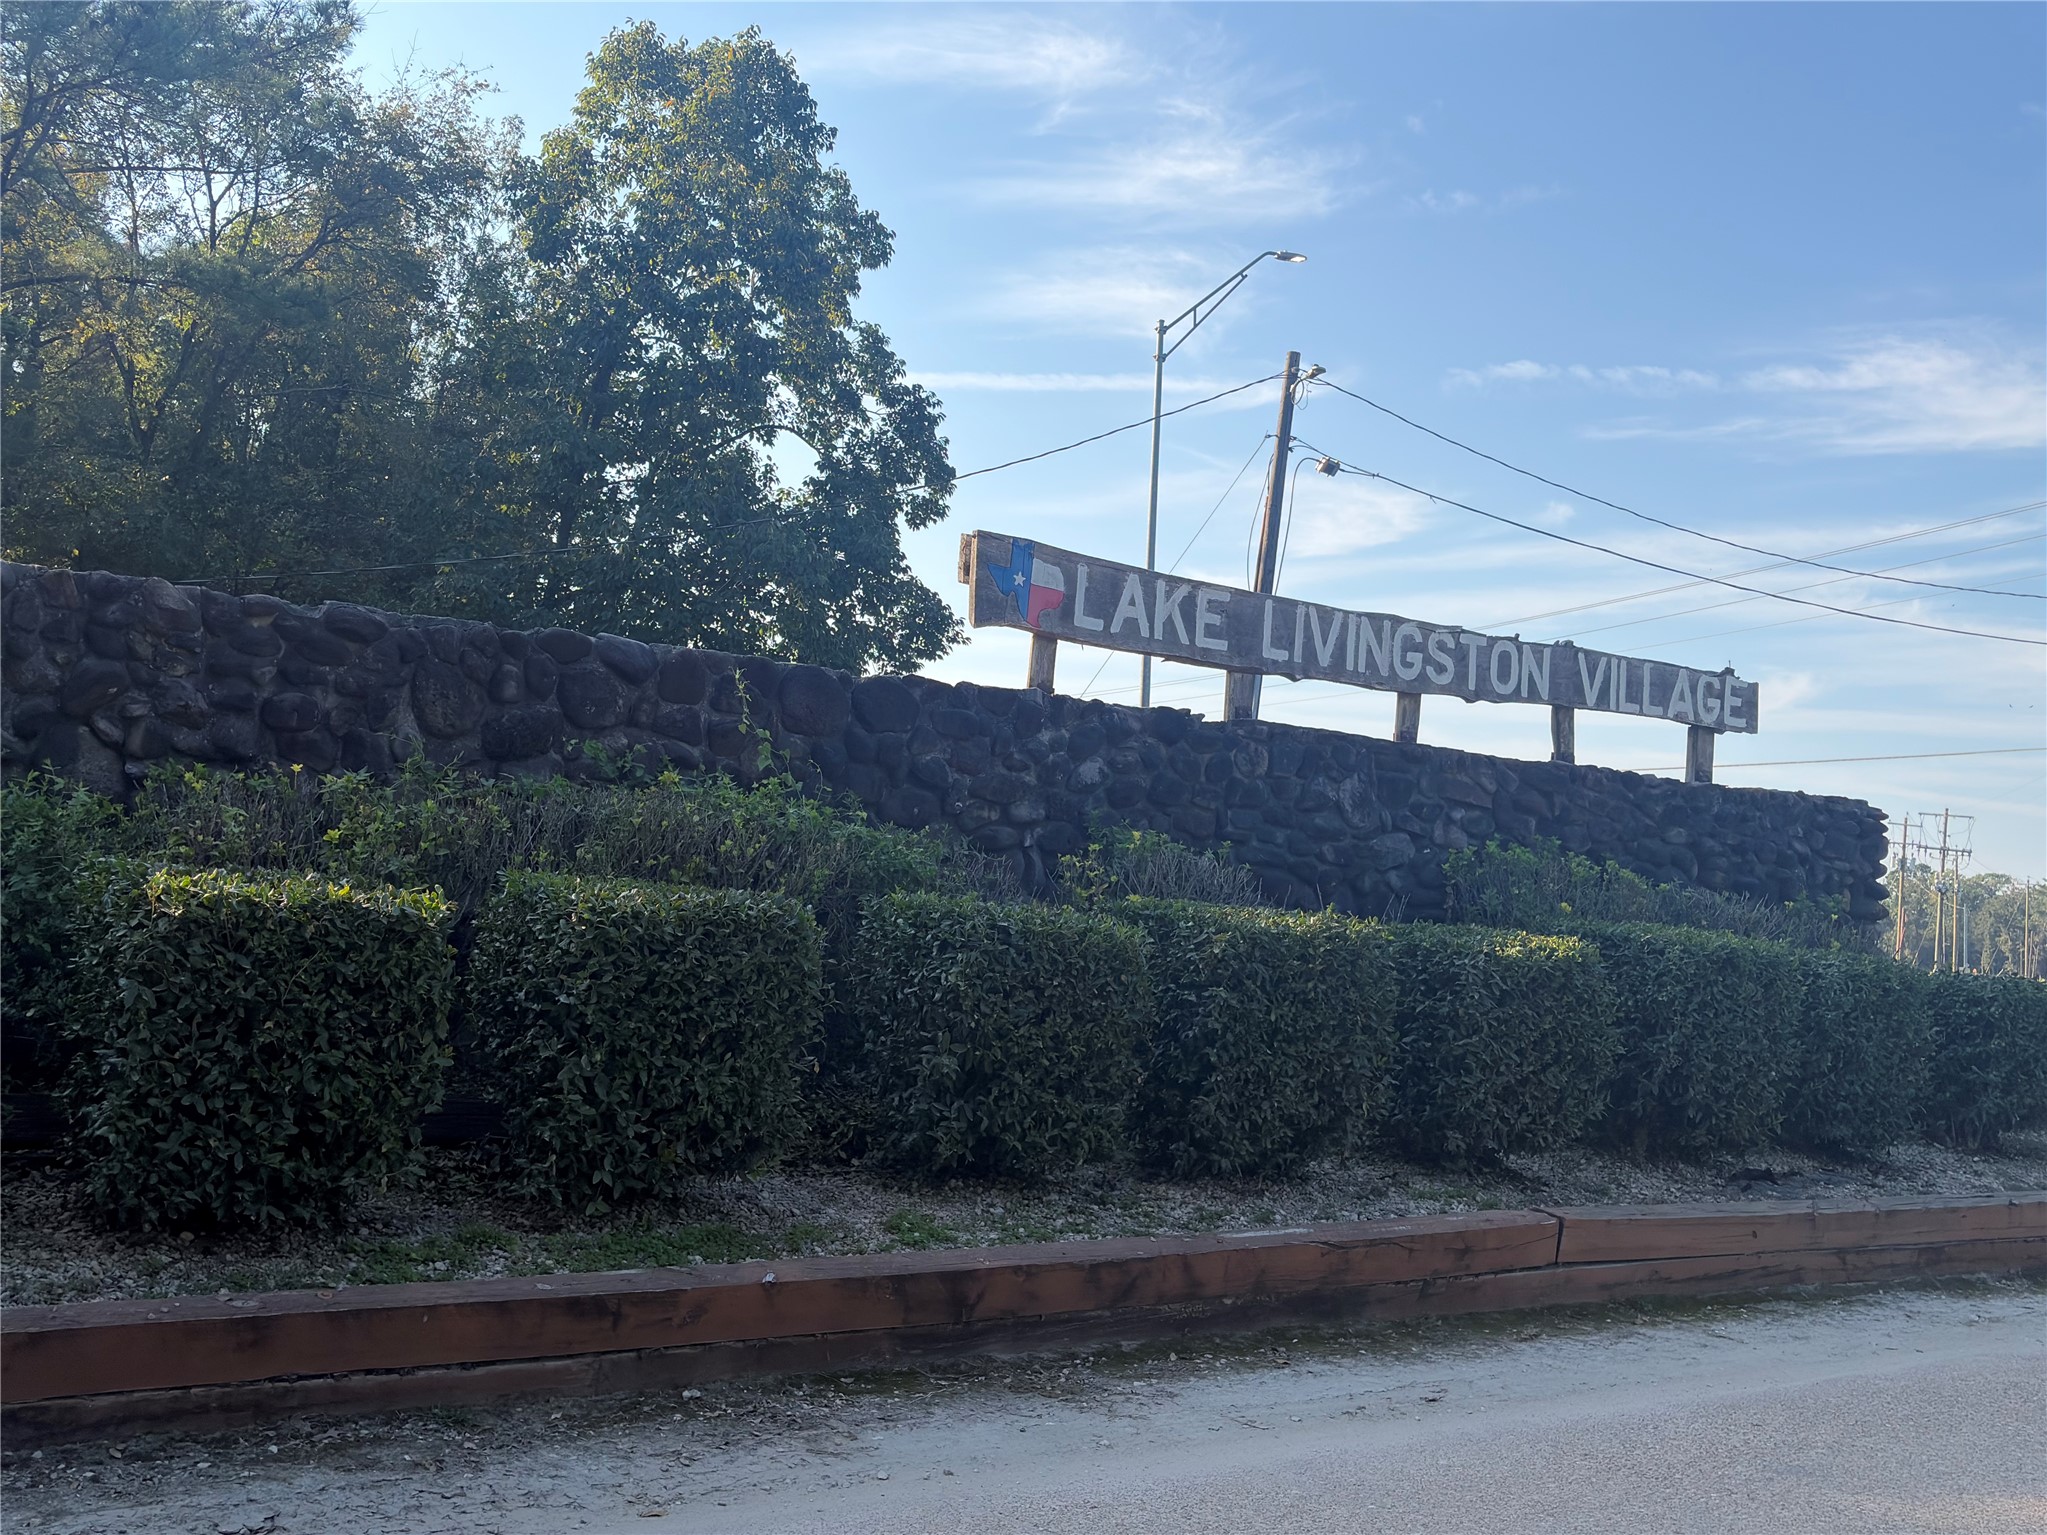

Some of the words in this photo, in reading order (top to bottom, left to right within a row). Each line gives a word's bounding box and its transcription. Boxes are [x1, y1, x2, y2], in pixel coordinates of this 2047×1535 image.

[1074, 563, 1232, 651] LAKE
[1262, 599, 1551, 700] LIVINGSTON
[1578, 651, 1748, 728] VILLAGE
